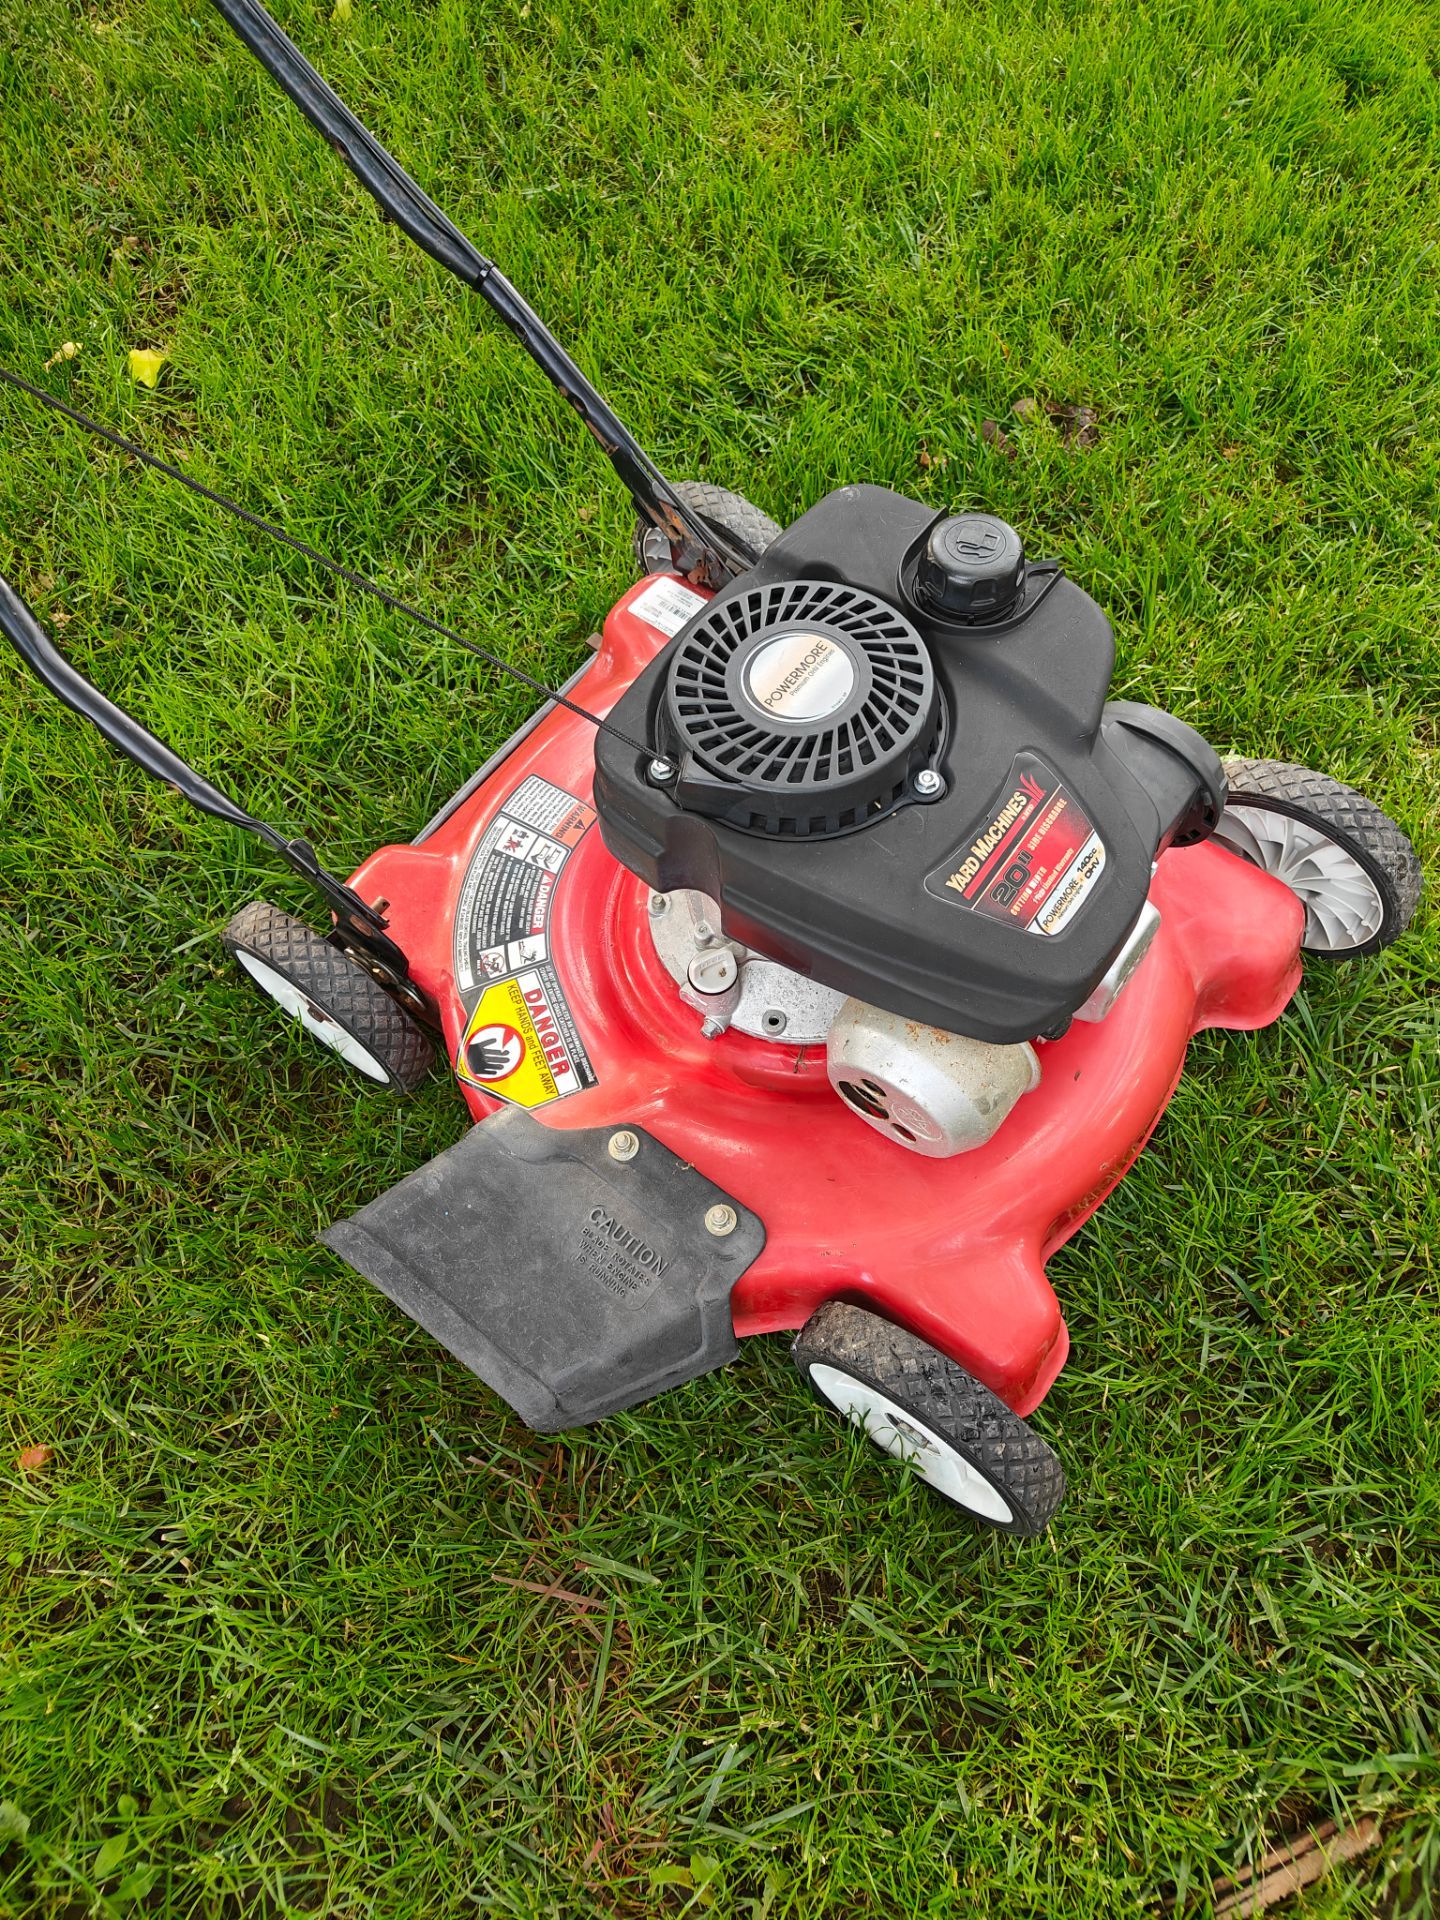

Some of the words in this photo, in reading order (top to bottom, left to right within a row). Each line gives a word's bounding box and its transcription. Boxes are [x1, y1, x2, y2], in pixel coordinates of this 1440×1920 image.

[764, 641, 828, 707] POWERMORE
[555, 805, 586, 838] WARNING
[945, 855, 980, 893] YARD
[970, 791, 1027, 860] MACHINES
[1027, 833, 1041, 851] SIDE
[1042, 798, 1068, 835] DISCHARGE
[1077, 847, 1098, 874] 140cc
[1084, 858, 1101, 879] OHV
[532, 885, 550, 929] DANGER
[1010, 887, 1032, 916] CUTTING
[1029, 866, 1047, 889] WIDTH
[1042, 879, 1079, 927] POWERMORE
[507, 984, 521, 1004] KEEP
[516, 1006, 532, 1034] HANDS
[524, 988, 570, 1077] DANGER
[526, 1035, 537, 1050] and
[532, 1048, 547, 1071] FEET
[539, 1072, 556, 1095] AWAY
[582, 1227, 610, 1252] BLADE
[612, 1251, 650, 1286] ROTATES
[589, 1207, 669, 1276] CAUTION
[576, 1253, 587, 1264] IS
[588, 1263, 626, 1297] RUNNING
[580, 1239, 605, 1263] WHEN
[606, 1262, 639, 1290] ENGINE
